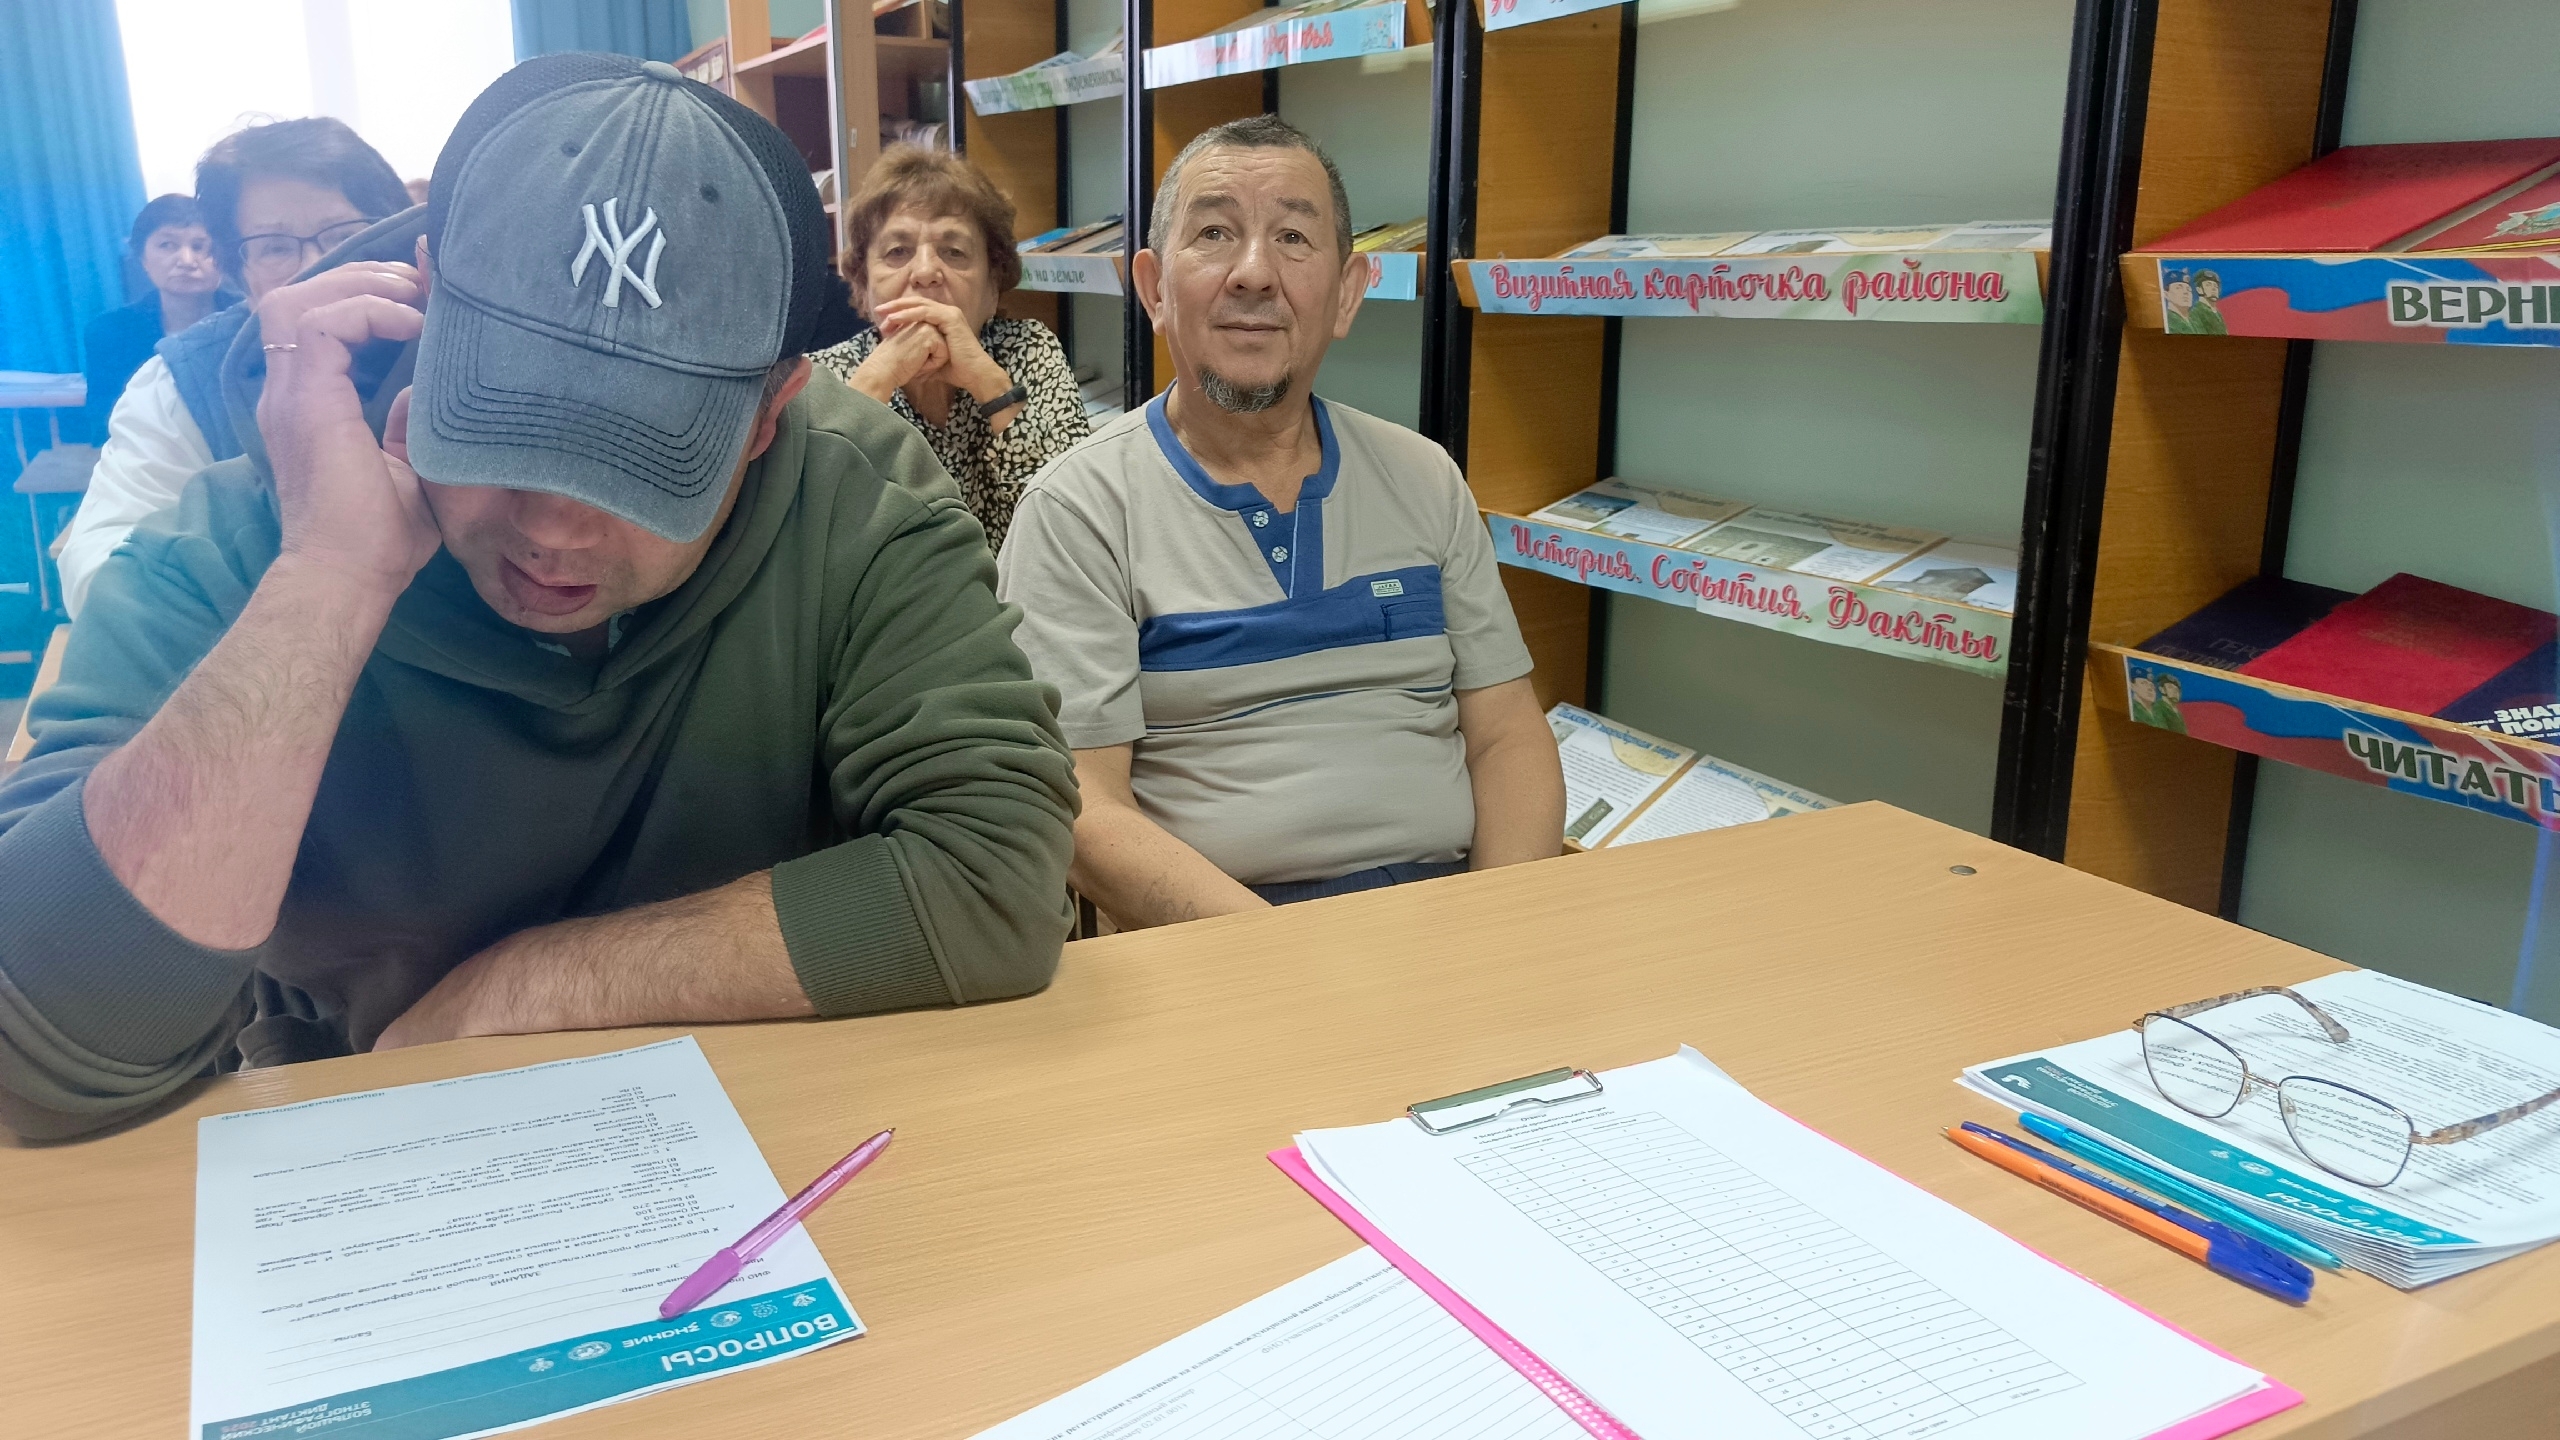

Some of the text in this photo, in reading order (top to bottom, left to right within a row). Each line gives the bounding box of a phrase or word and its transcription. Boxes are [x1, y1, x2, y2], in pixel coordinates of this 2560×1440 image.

[571, 197, 667, 310] NY
[1051, 268, 1086, 285] земле
[1489, 257, 2009, 317] Визитная карточка района
[2390, 284, 2560, 324] ВЕРН
[1510, 523, 2001, 663] История. События. Факты
[658, 1312, 841, 1373] ВОПРОСЫ
